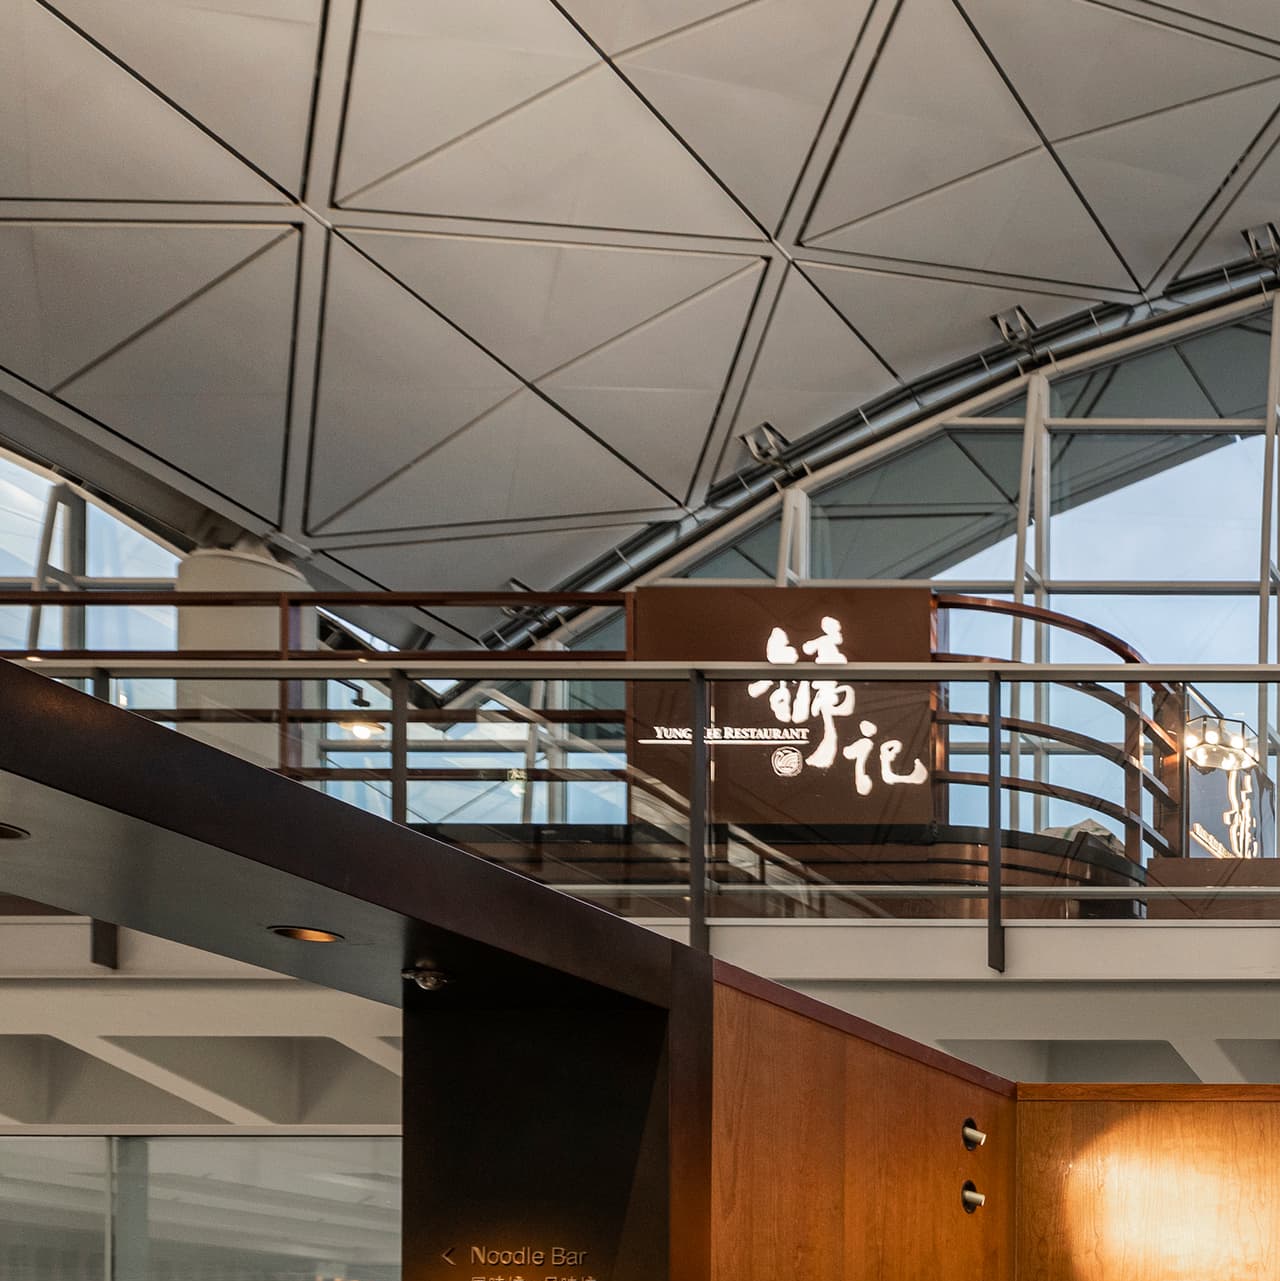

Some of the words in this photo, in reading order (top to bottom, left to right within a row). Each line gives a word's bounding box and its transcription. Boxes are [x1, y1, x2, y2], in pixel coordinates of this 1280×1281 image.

[653, 726, 692, 740] YUNG
[703, 726, 722, 740] EE
[723, 726, 810, 740] RESTAURANT
[470, 1246, 545, 1266] Noodle
[551, 1247, 588, 1266] Bar
